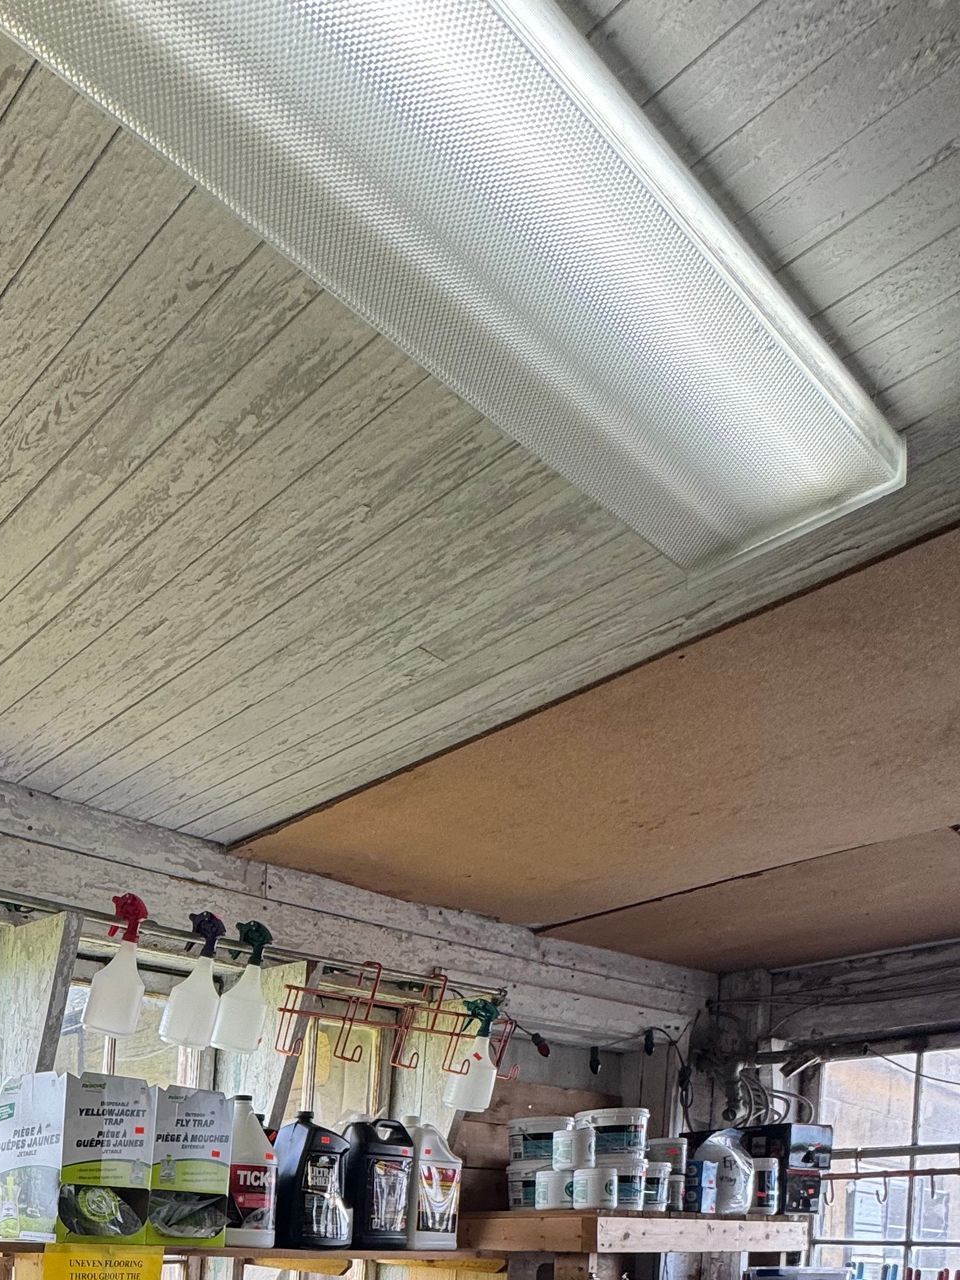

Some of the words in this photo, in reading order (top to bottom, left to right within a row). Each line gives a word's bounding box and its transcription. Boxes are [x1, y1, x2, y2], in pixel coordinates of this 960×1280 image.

[78, 1107, 147, 1118] YELLOWJACKET
[175, 1118, 191, 1128] FLY
[192, 1119, 215, 1128] TRAP
[97, 1130, 121, 1139] PIÈGE
[156, 1131, 181, 1143] PIÈGE
[190, 1134, 230, 1144] MOUCHES
[27, 1133, 61, 1148] JAUNES
[76, 1138, 111, 1148] GUÊPES
[112, 1139, 144, 1148] JAUNES
[69, 1260, 103, 1268] UNEVEN
[104, 1260, 143, 1268] FLOORING
[69, 1272, 125, 1280] THROUGHOUT
[126, 1272, 141, 1280] THE
